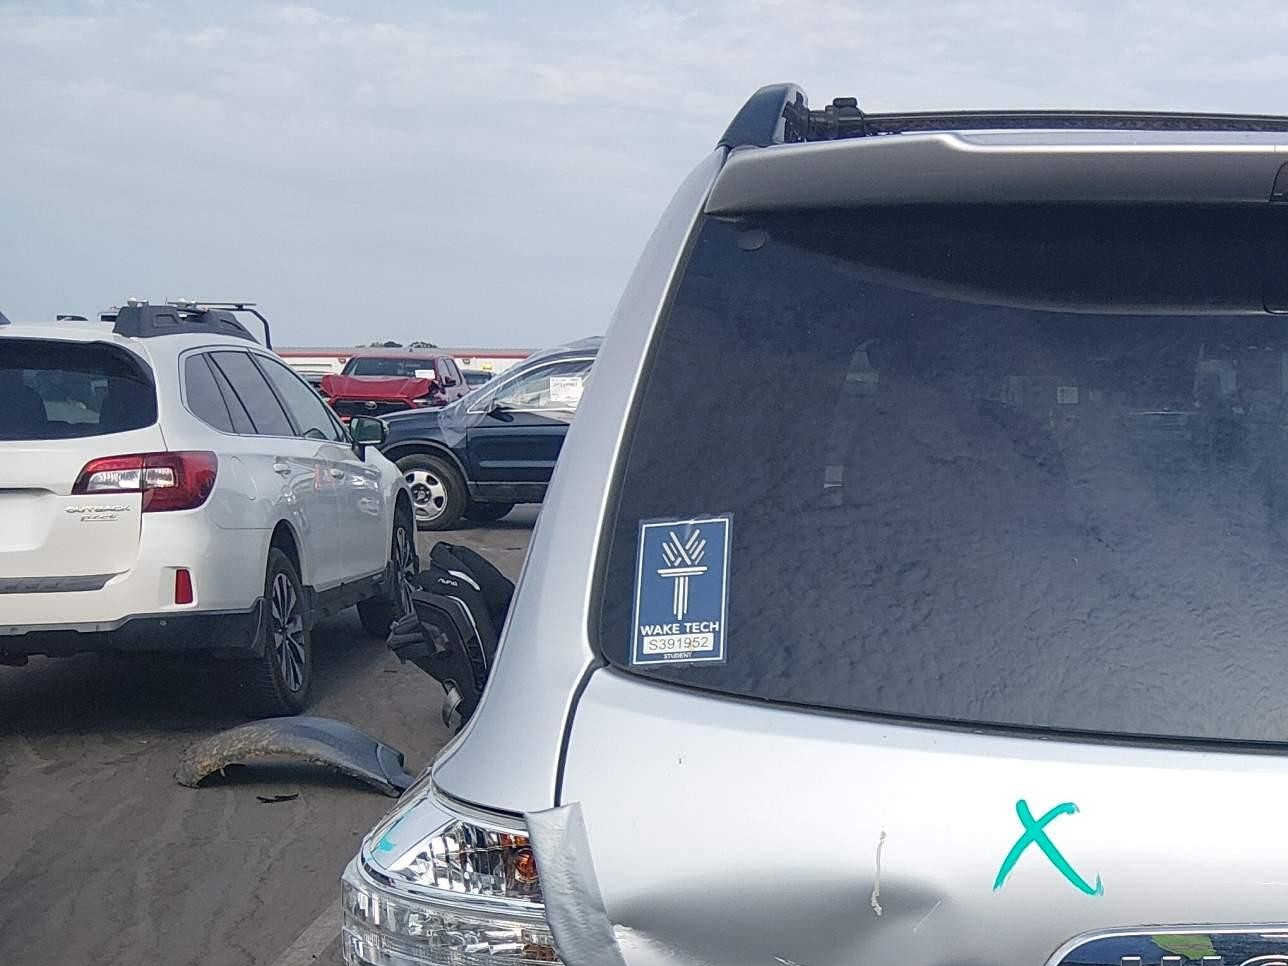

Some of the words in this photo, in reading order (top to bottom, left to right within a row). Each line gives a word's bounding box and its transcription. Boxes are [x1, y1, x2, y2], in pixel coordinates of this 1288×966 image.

[64, 503, 131, 513] OUTBACK
[640, 624, 680, 635] WAKE
[685, 622, 719, 633] TECH
[649, 637, 708, 650] S391952
